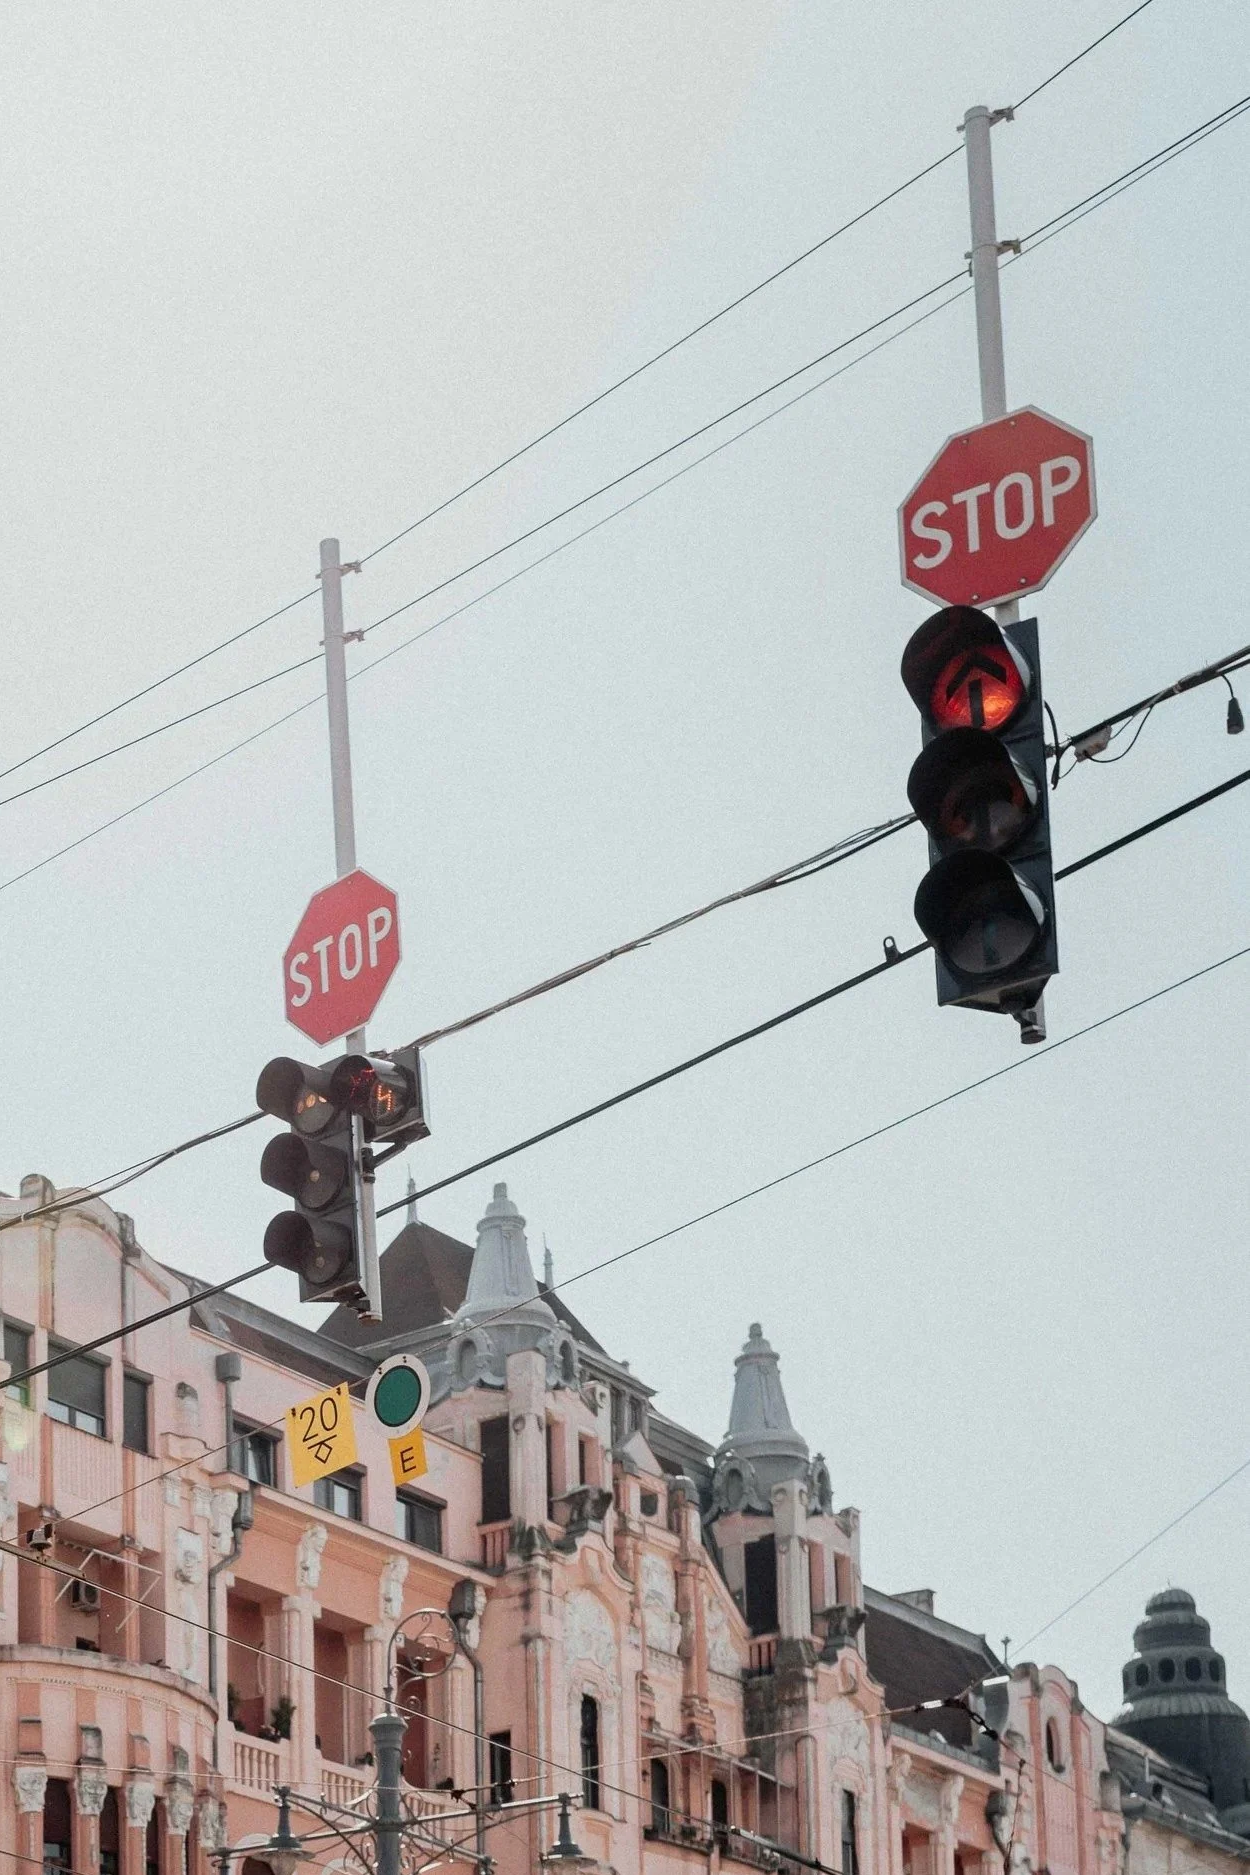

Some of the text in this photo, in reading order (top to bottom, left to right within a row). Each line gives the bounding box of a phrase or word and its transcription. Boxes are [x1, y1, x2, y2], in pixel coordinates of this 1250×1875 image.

[910, 454, 1082, 570] STOP
[289, 905, 393, 1008] STOP
[300, 1396, 338, 1443] 20
[400, 1446, 416, 1474] E
